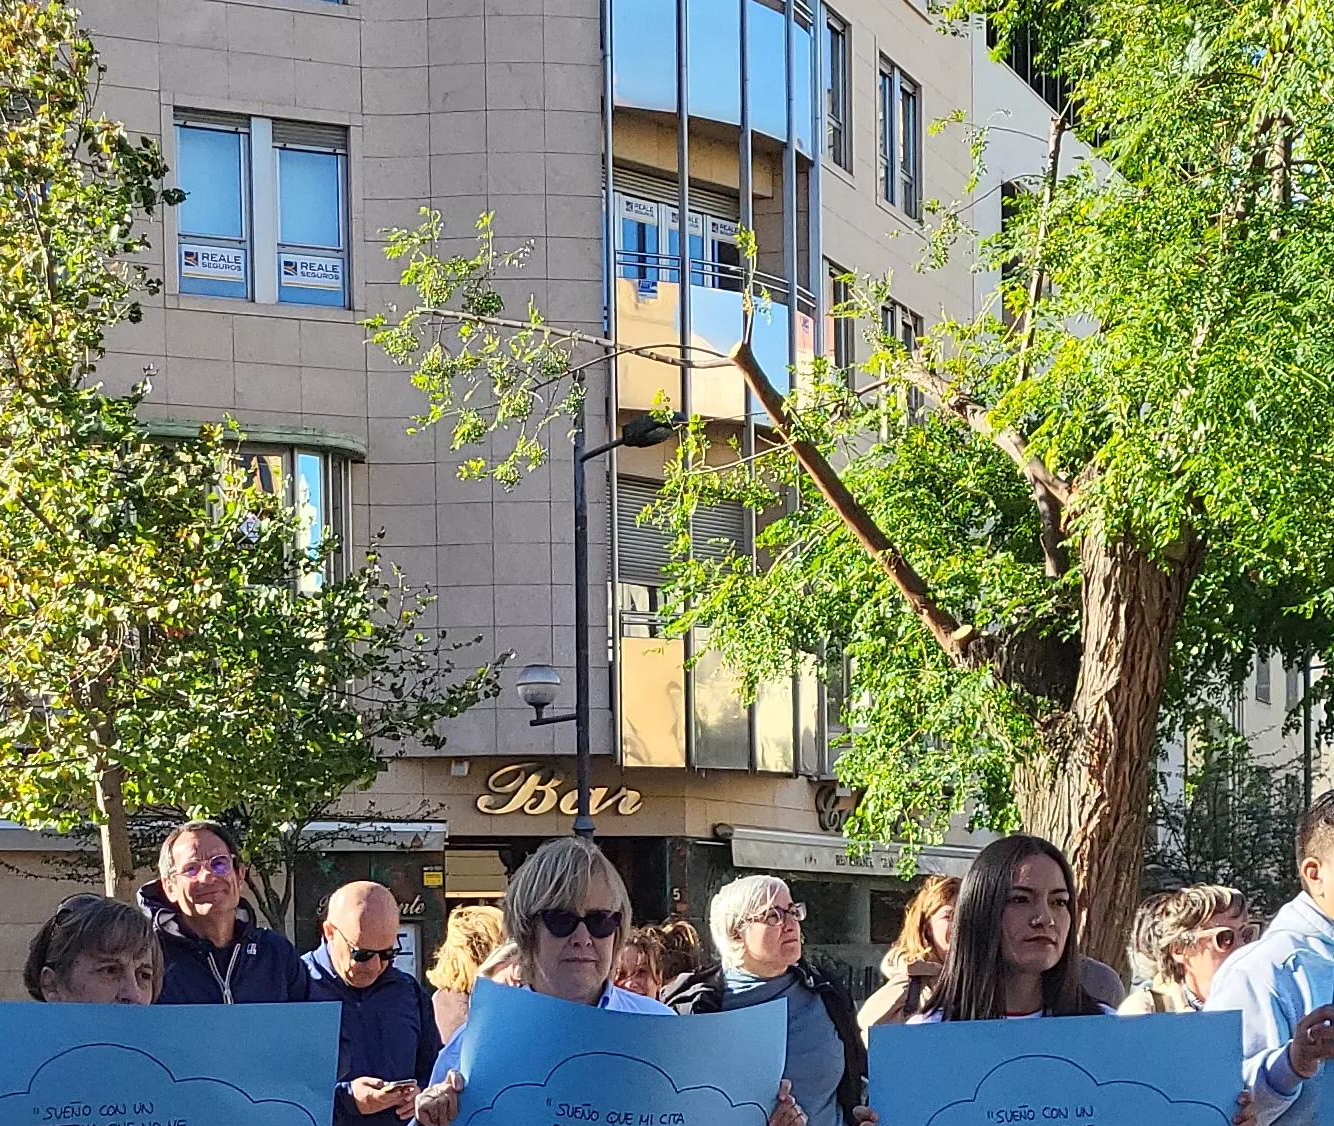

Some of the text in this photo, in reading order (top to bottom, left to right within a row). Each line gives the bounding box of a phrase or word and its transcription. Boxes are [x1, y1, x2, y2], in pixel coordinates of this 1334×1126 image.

[201, 253, 242, 264] REALE
[201, 261, 242, 272] SEGUROS
[300, 262, 340, 273] REALE
[300, 271, 340, 280] SEGUROS
[476, 762, 644, 815] Bar
[672, 887, 681, 901] 5
[99, 1103, 126, 1116] CON
[134, 1102, 153, 1114] UN
[1043, 1106, 1068, 1118] CON
[1076, 1105, 1093, 1118] UN
[606, 1111, 634, 1125] QUE
[639, 1114, 653, 1125] MI
[659, 1113, 684, 1125] CITA
